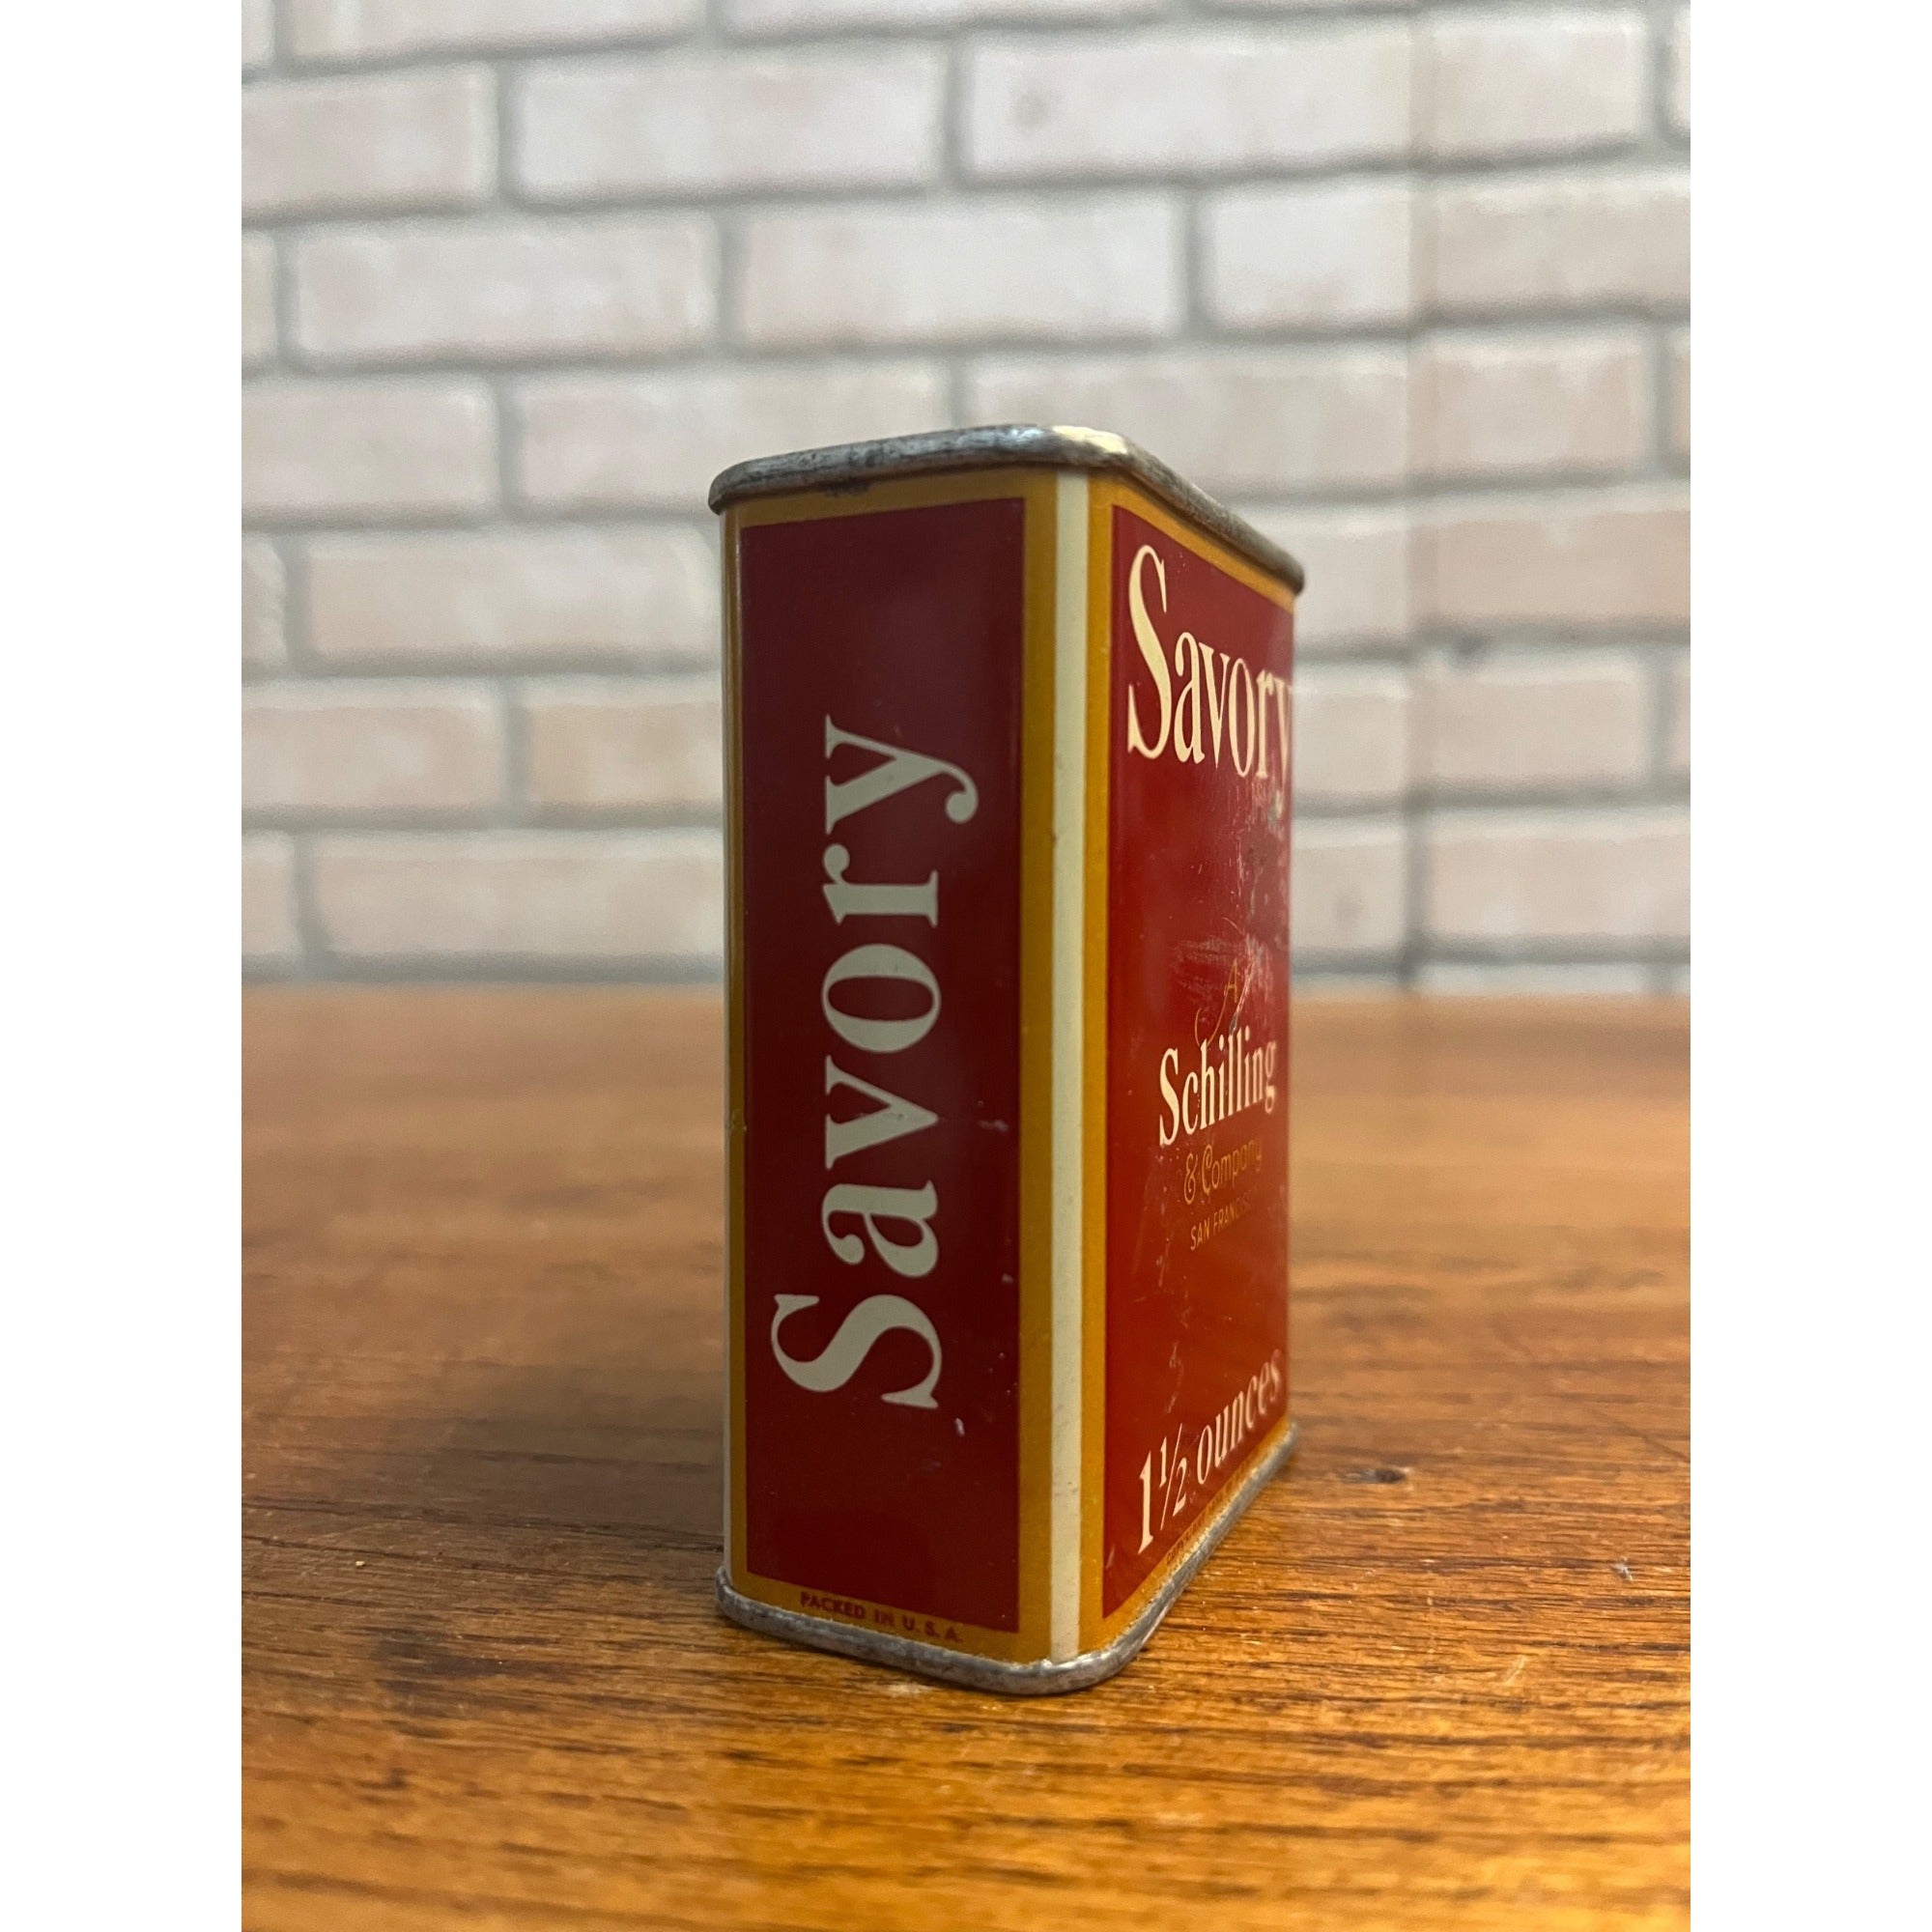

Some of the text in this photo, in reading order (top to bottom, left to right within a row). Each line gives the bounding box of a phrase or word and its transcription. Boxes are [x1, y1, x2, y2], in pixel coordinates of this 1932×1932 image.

[1127, 544, 1293, 818] Savory
[772, 714, 978, 1408] Savory
[1159, 1025, 1276, 1146] Schilling
[1184, 1144, 1262, 1205] & Company
[1190, 1216, 1209, 1250] SAN
[1197, 1349, 1282, 1485] ounces
[800, 1591, 867, 1620] PACKED
[874, 1609, 895, 1627] IN
